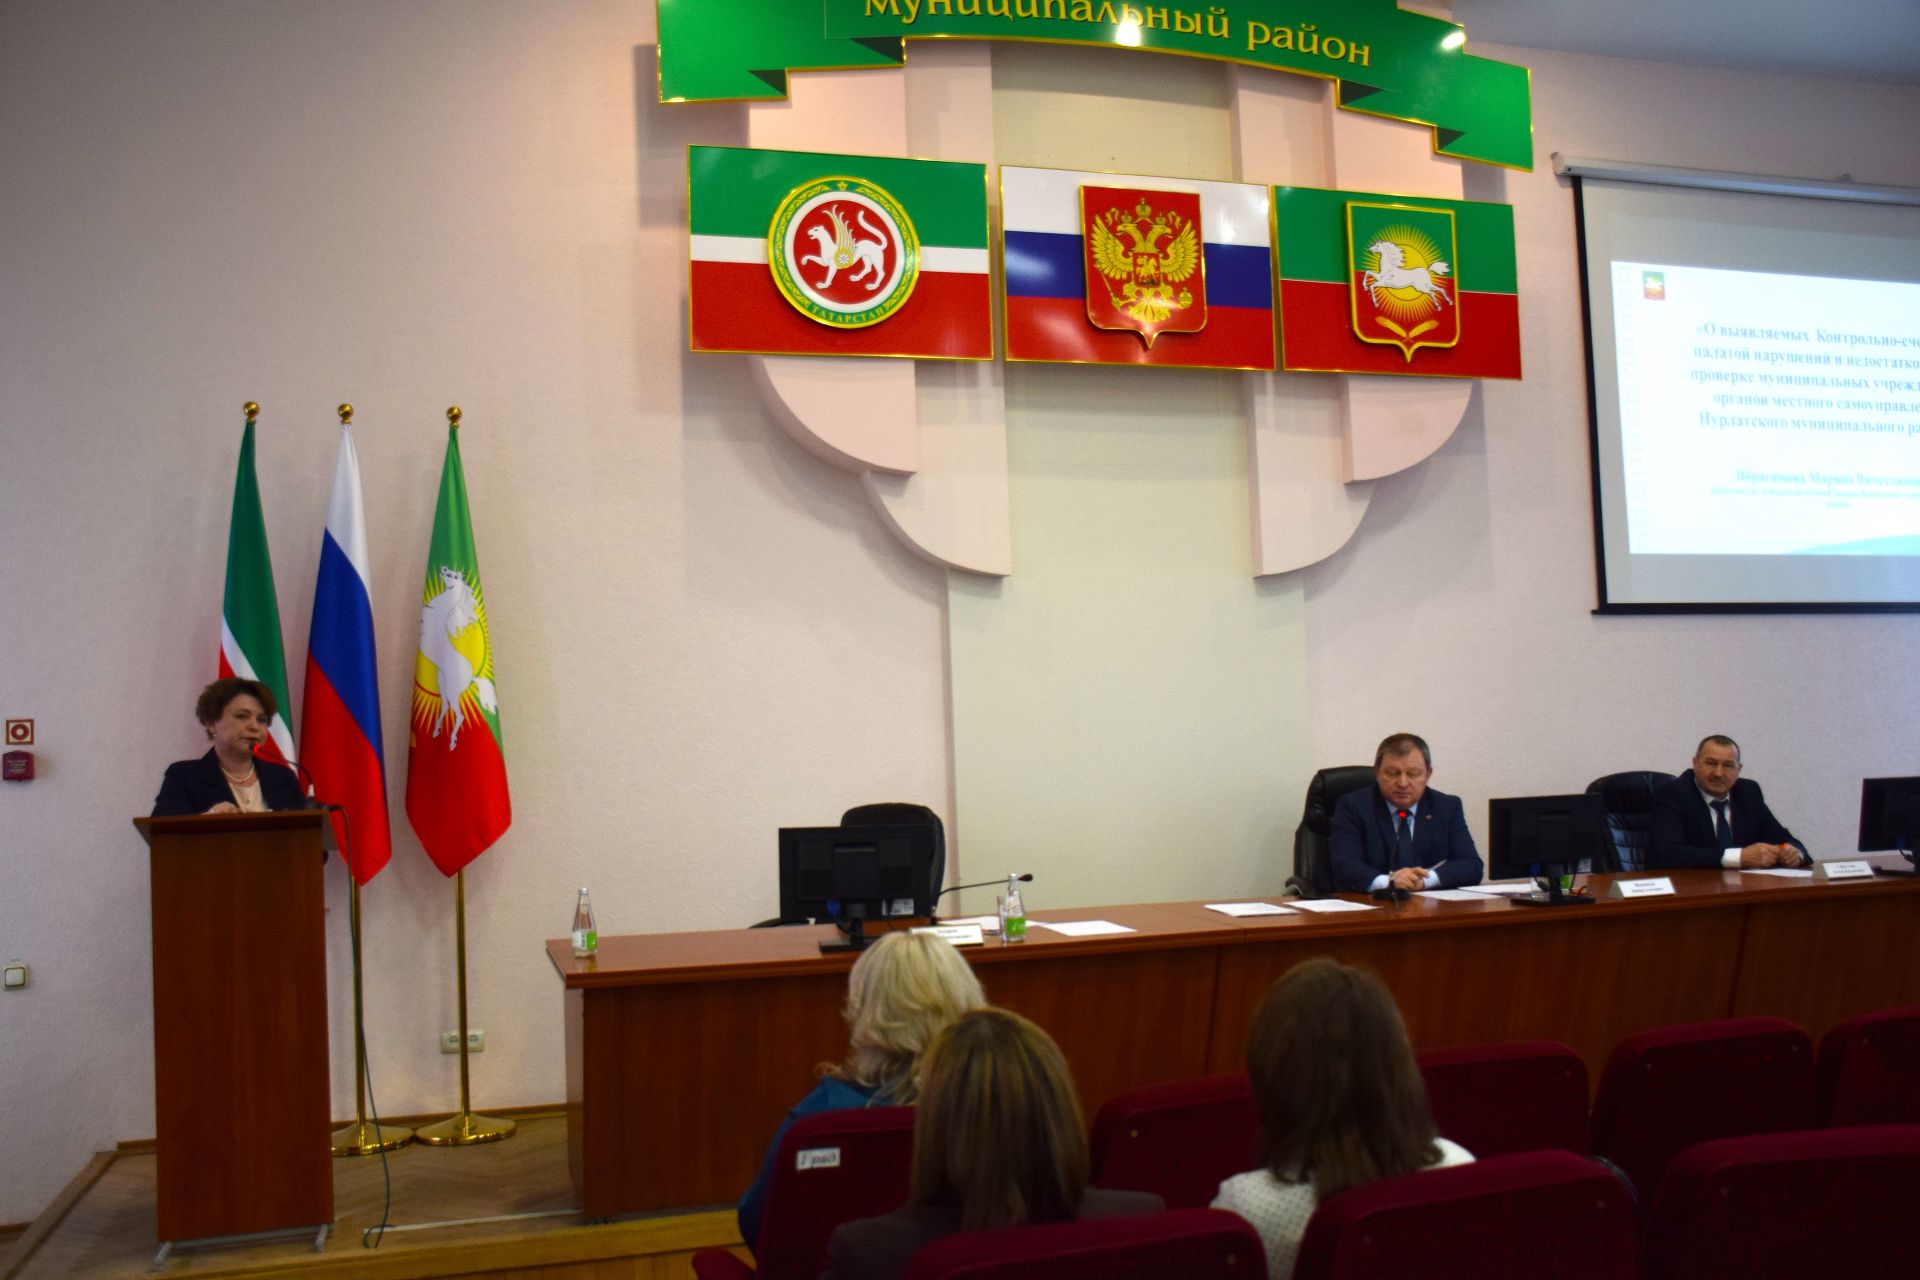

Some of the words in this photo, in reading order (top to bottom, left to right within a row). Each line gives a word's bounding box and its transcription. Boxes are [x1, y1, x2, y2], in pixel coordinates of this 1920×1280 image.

[1247, 23, 1371, 66] район
[811, 304, 884, 323] ТАТАРСТАН
[1720, 326, 1809, 342] выявляемых
[1693, 347, 1750, 361] палатой
[1754, 351, 1831, 366] нарушений
[1835, 355, 1842, 366] и
[1690, 369, 1754, 386] проверке
[1758, 374, 1869, 389] муниципальных
[1713, 393, 1768, 407] органов
[1772, 396, 1833, 409] местного
[1699, 411, 1788, 430] Нурлатского
[1791, 418, 1905, 433] муниципального
